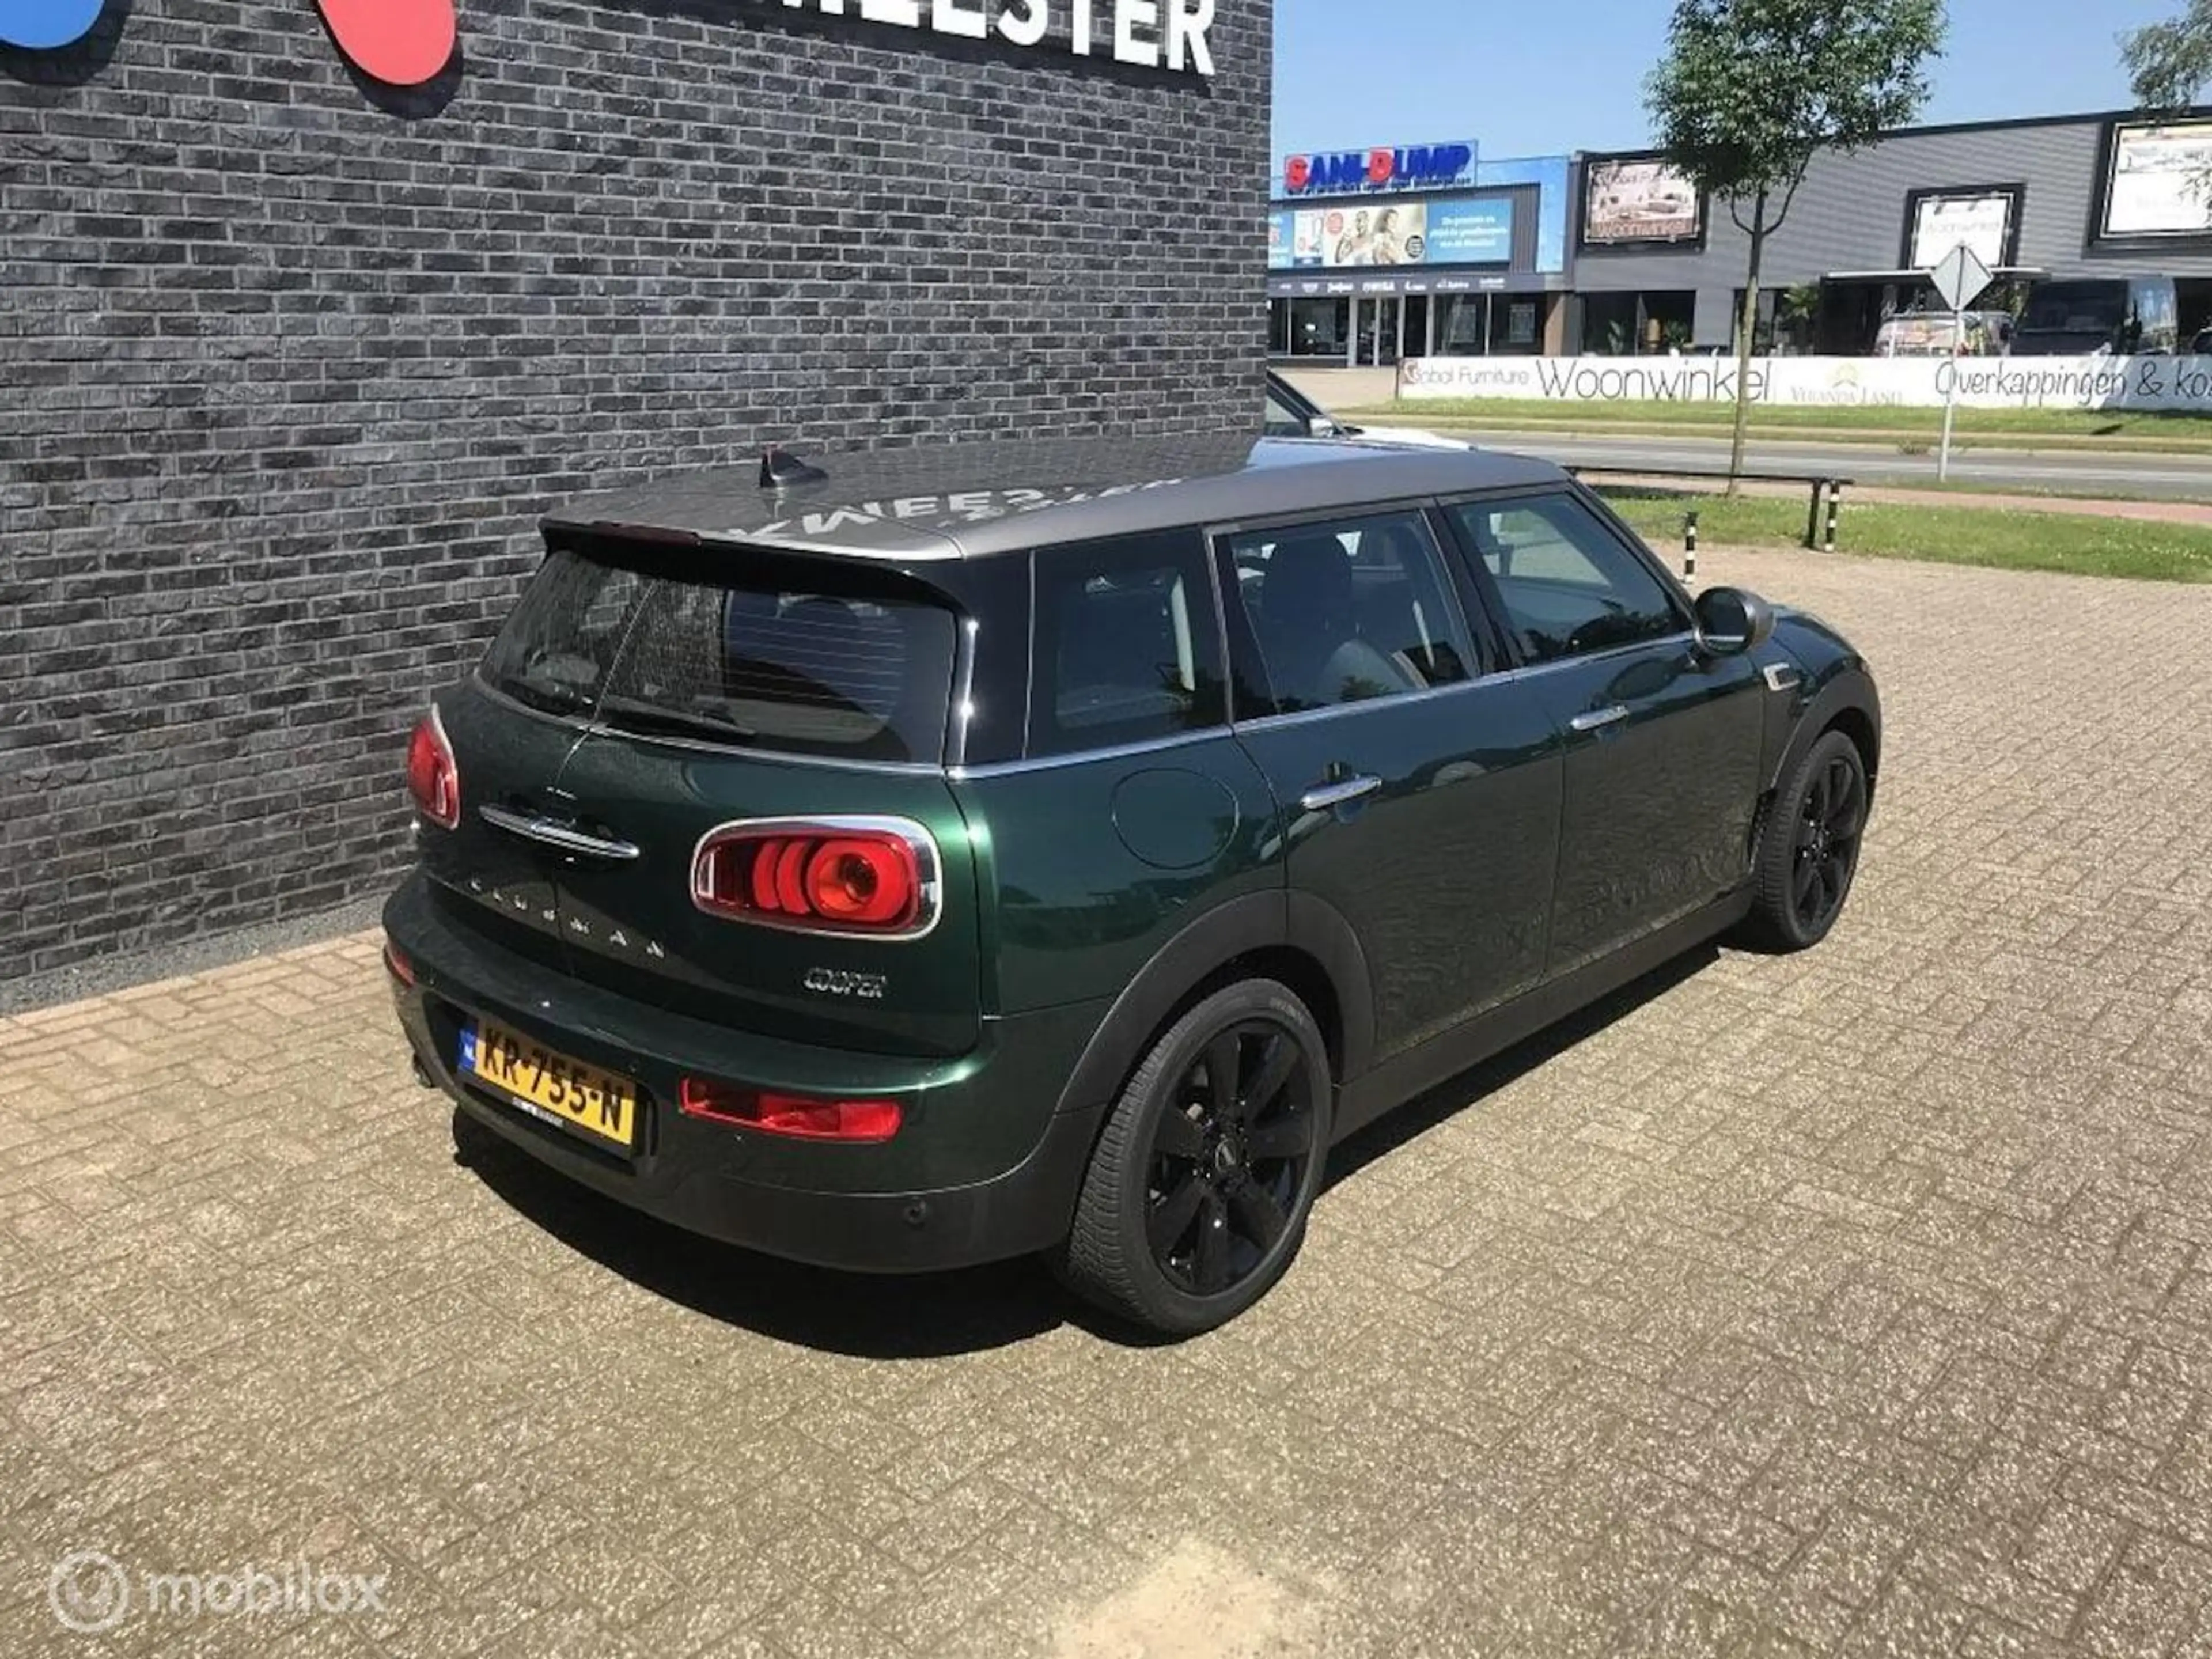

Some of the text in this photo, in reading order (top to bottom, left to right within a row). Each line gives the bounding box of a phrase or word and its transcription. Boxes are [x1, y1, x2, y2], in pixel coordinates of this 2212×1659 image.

[1536, 359, 1772, 401] Woonwinkel
[1935, 361, 2127, 407] Overkappingen
[2137, 360, 2164, 396] &
[483, 1028, 625, 1133] KR-755-N
